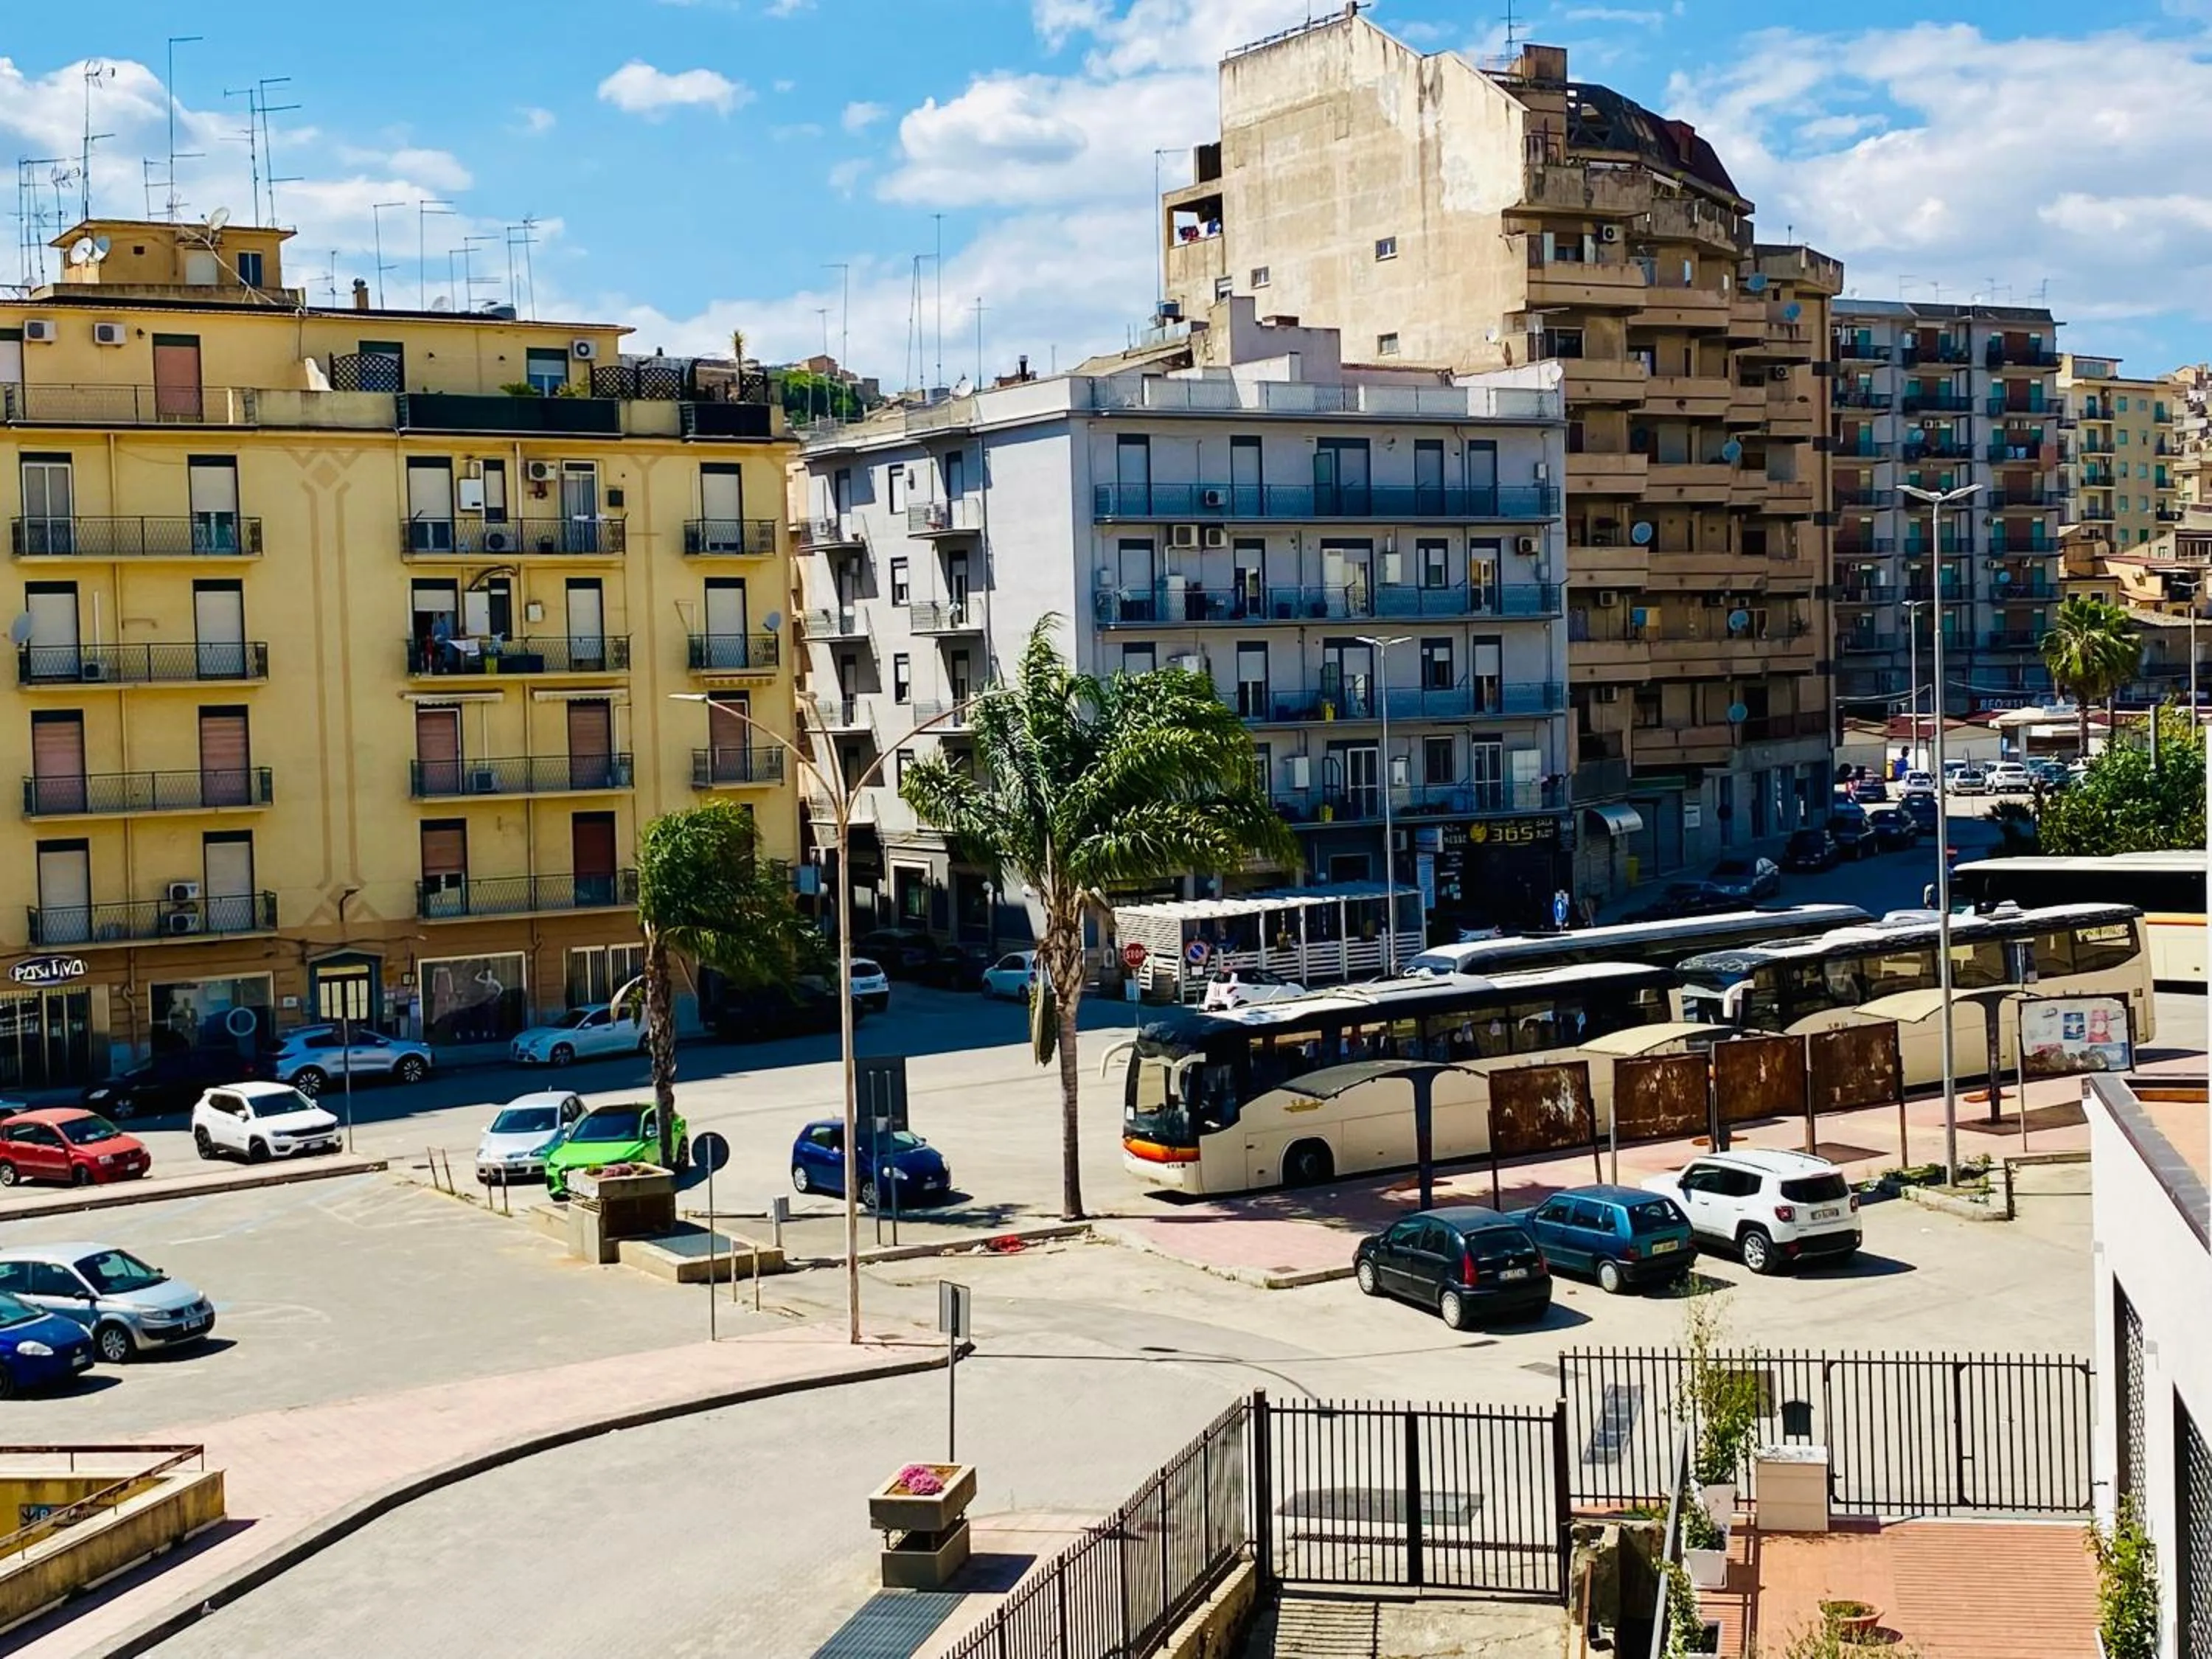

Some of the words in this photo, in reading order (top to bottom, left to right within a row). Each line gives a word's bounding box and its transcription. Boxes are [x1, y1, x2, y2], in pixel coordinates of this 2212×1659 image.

[1490, 826, 1533, 842] 365
[1126, 949, 1144, 959] STOP
[15, 959, 85, 981] POSITIVO
